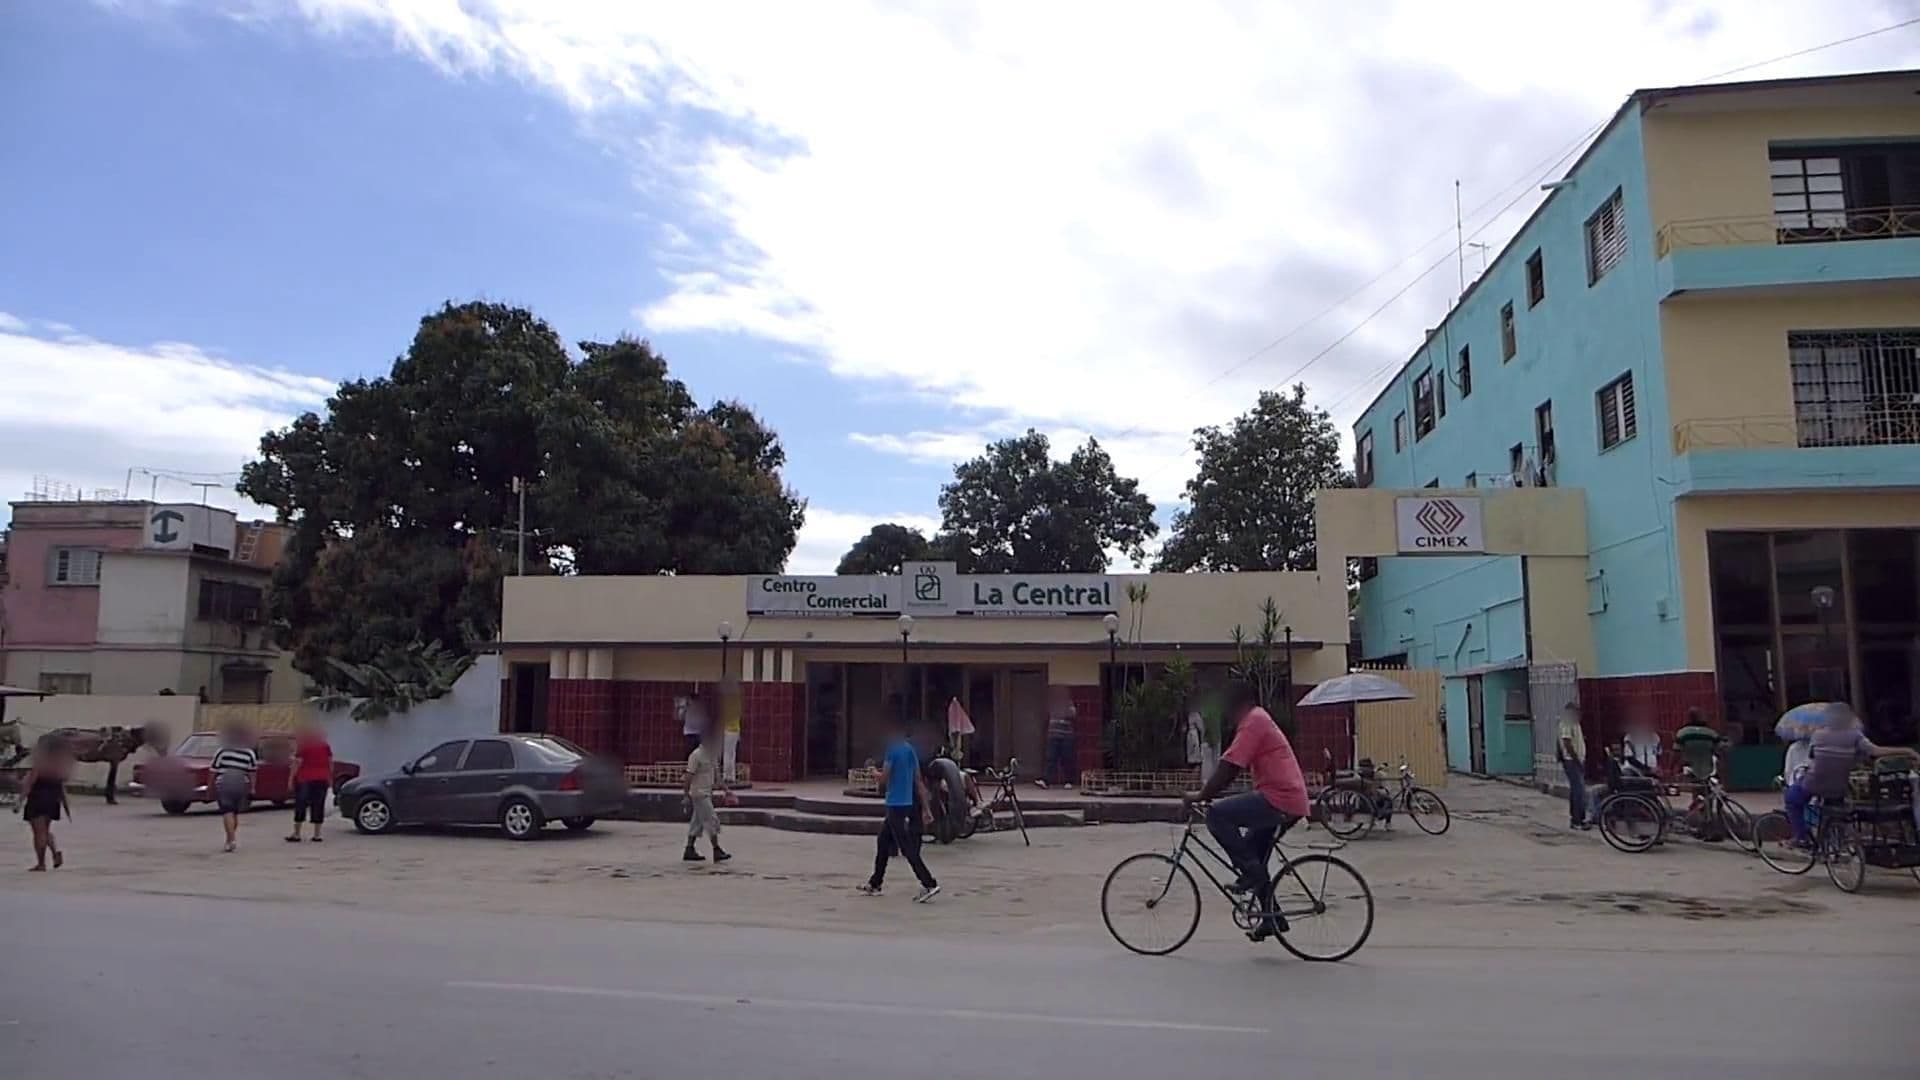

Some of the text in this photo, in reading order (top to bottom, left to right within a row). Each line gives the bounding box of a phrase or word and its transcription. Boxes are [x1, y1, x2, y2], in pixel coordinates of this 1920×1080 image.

[1415, 536, 1468, 547] CIMEX
[762, 578, 817, 592] Centro
[806, 594, 887, 608] Comercial
[973, 582, 1110, 606] La Central
